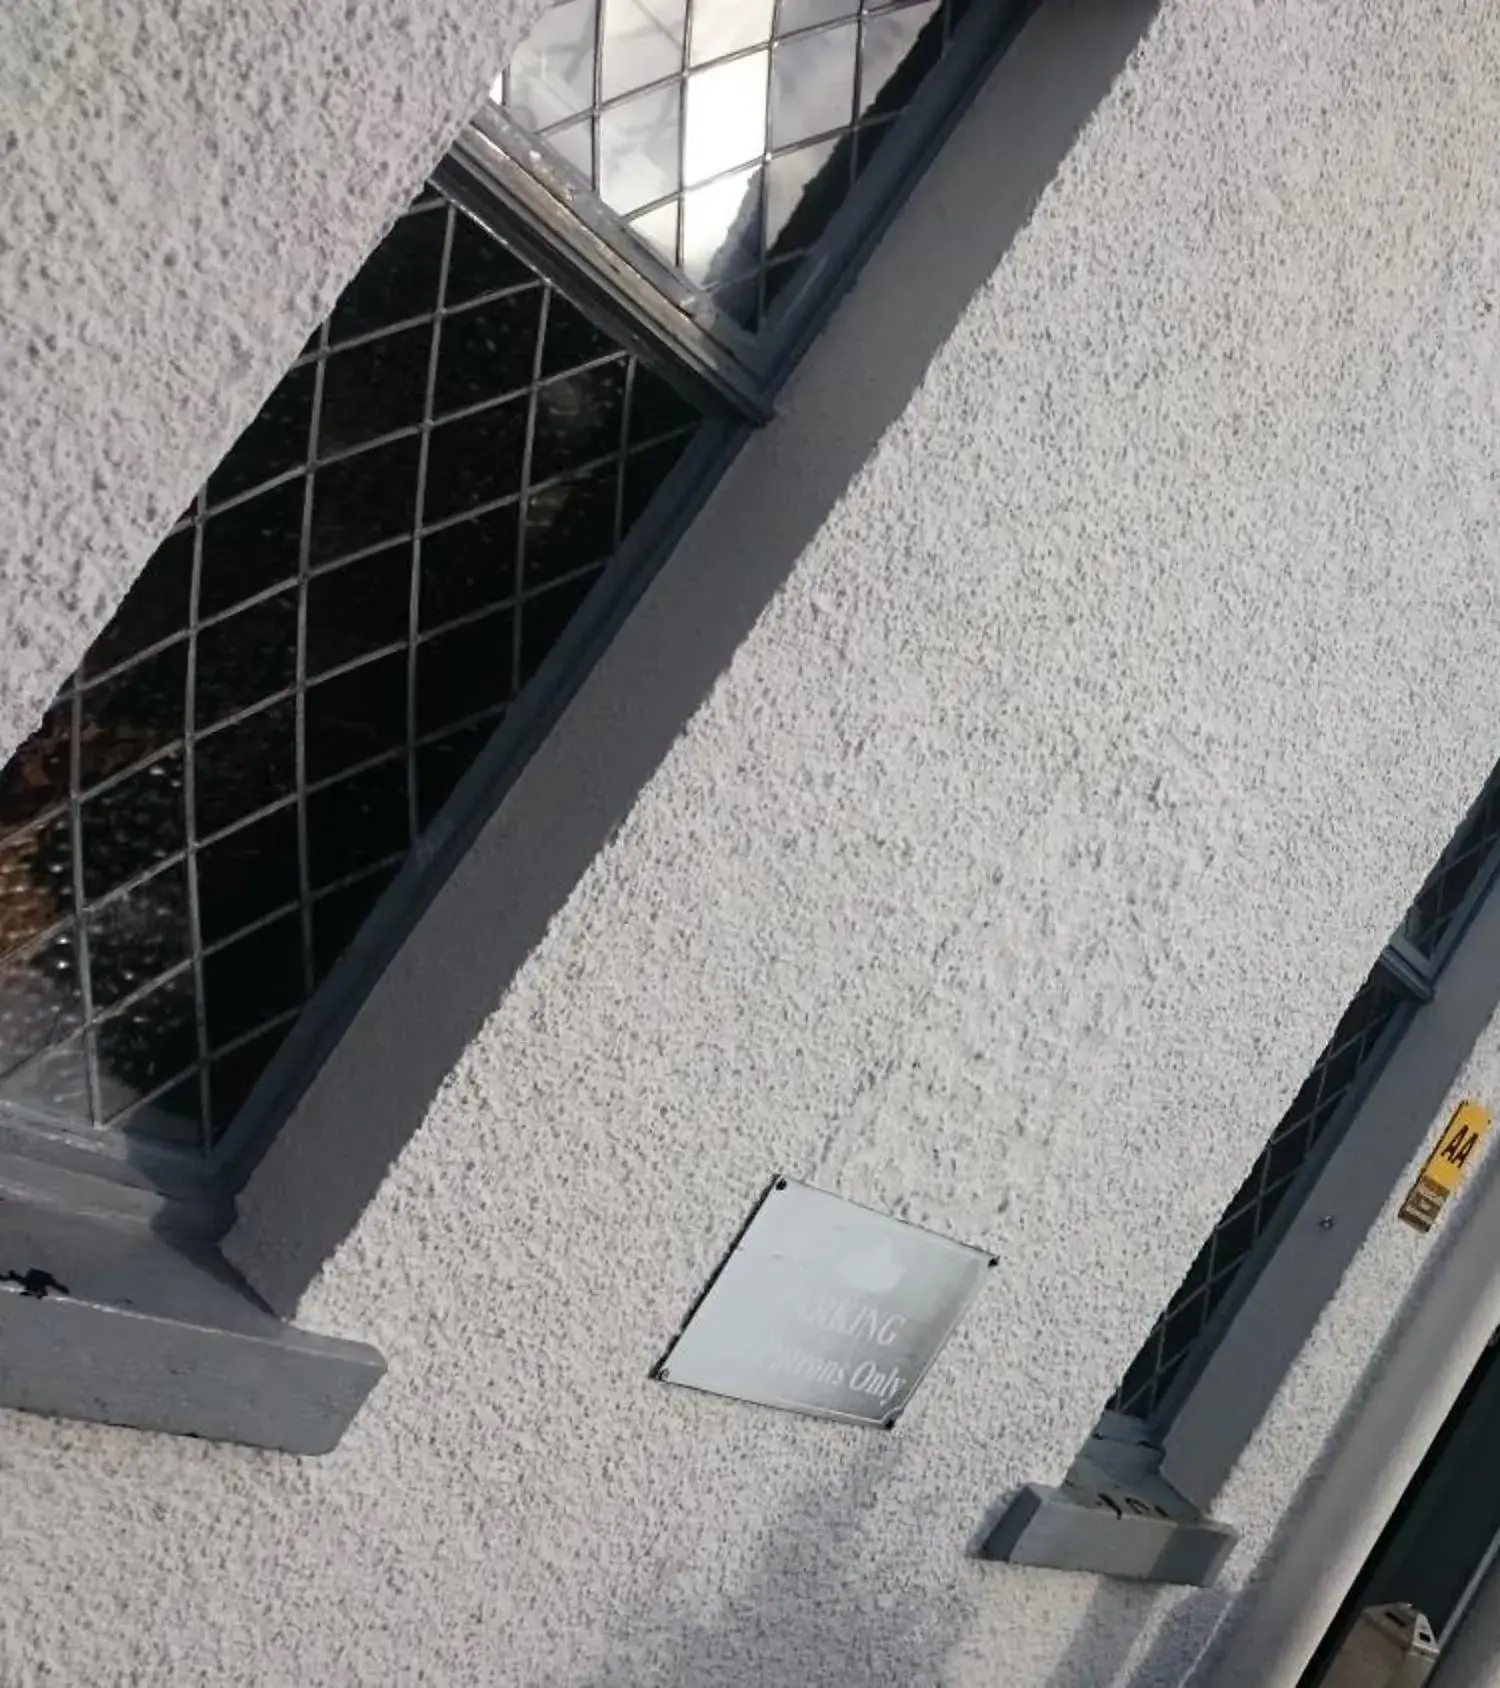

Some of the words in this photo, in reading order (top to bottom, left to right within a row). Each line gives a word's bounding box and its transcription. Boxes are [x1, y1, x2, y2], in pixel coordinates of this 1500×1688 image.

[1440, 1123, 1479, 1169] AA
[797, 1293, 907, 1346] RKING
[849, 1359, 907, 1406] Only
